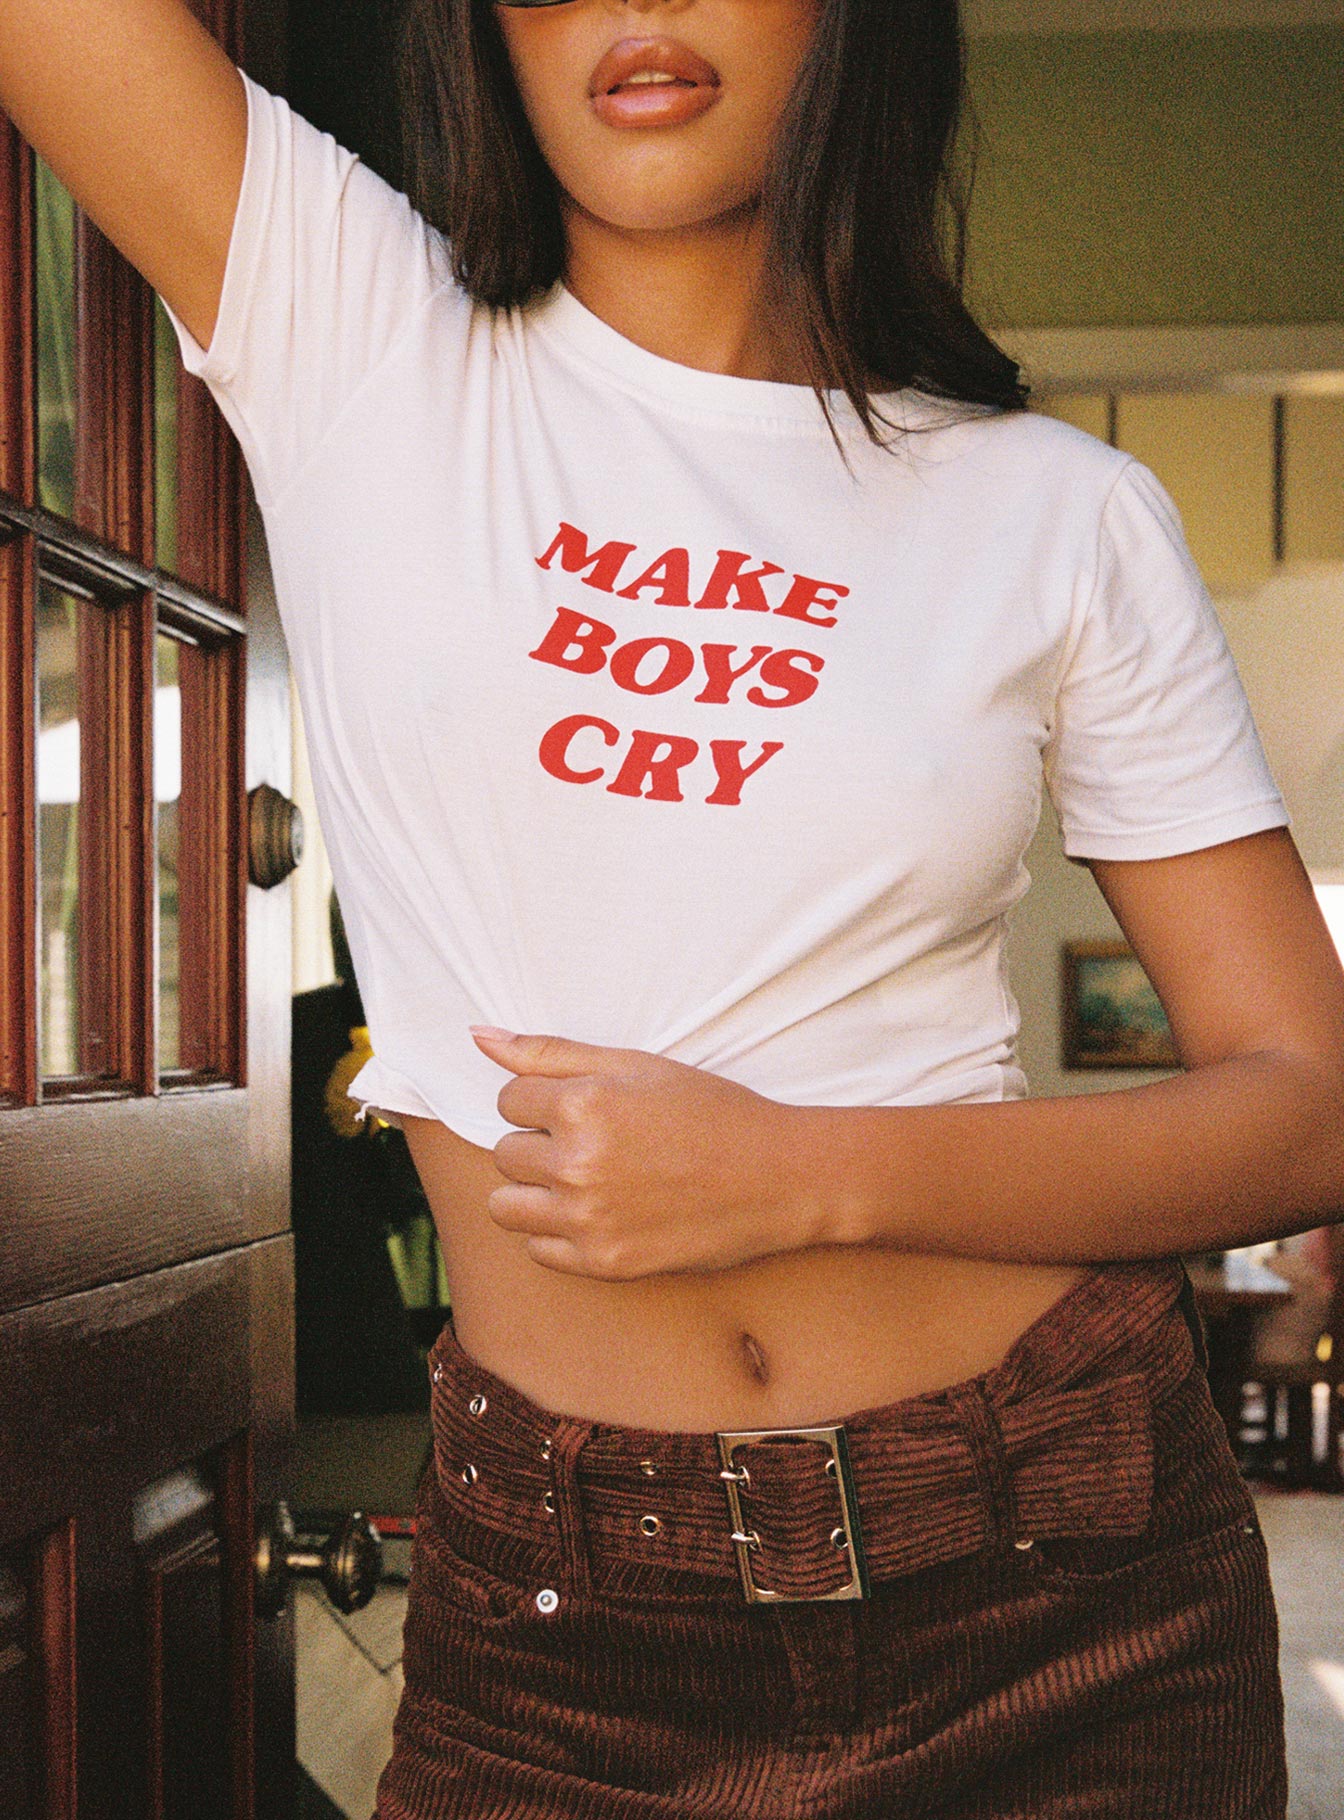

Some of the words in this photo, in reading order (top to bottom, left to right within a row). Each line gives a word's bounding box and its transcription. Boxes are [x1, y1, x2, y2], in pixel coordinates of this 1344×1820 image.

[535, 522, 850, 628] MAKE
[528, 606, 825, 708] BOYS
[539, 714, 784, 806] CRY
